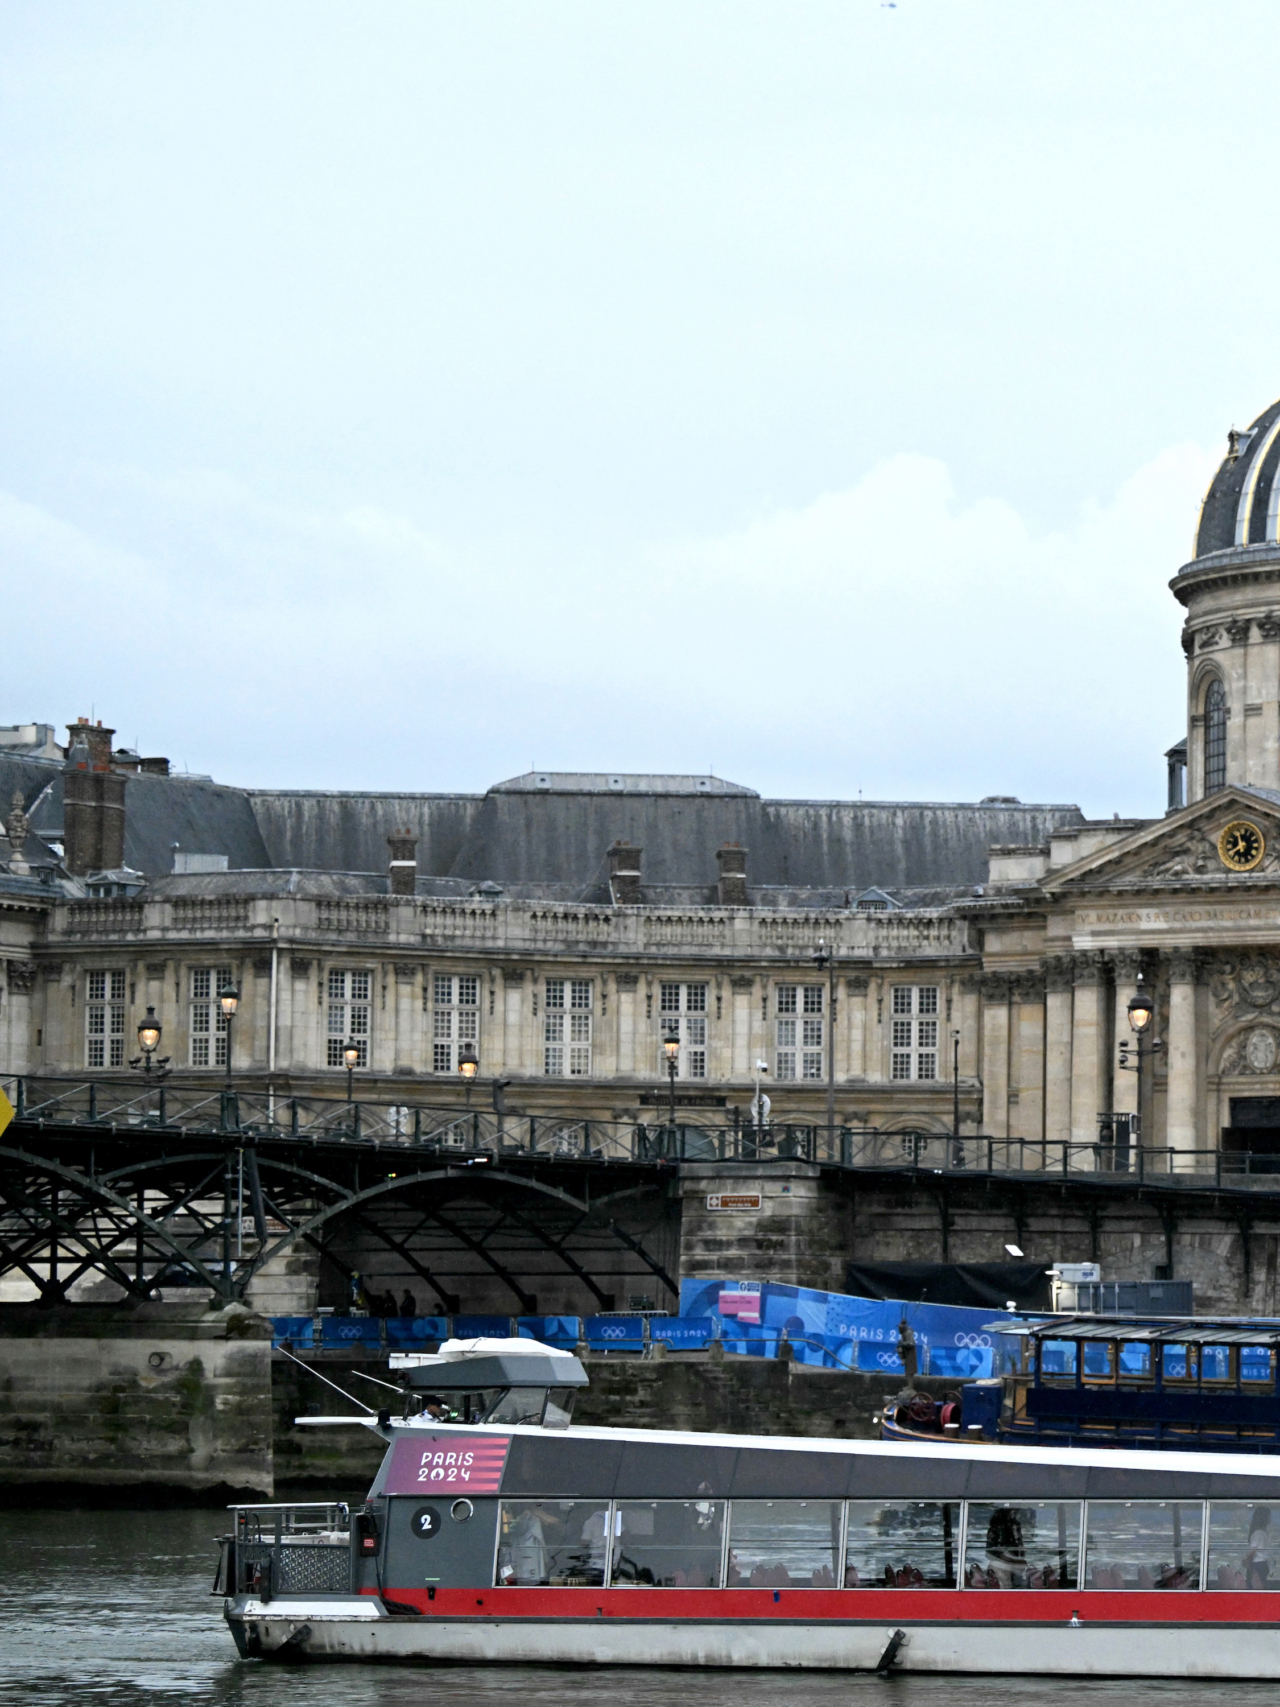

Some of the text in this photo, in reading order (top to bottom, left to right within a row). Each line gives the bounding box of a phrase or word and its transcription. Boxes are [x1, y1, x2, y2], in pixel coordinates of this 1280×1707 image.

[889, 1328, 929, 1345] 224
[416, 1467, 471, 1482] 2024
[420, 1514, 432, 1531] 2
